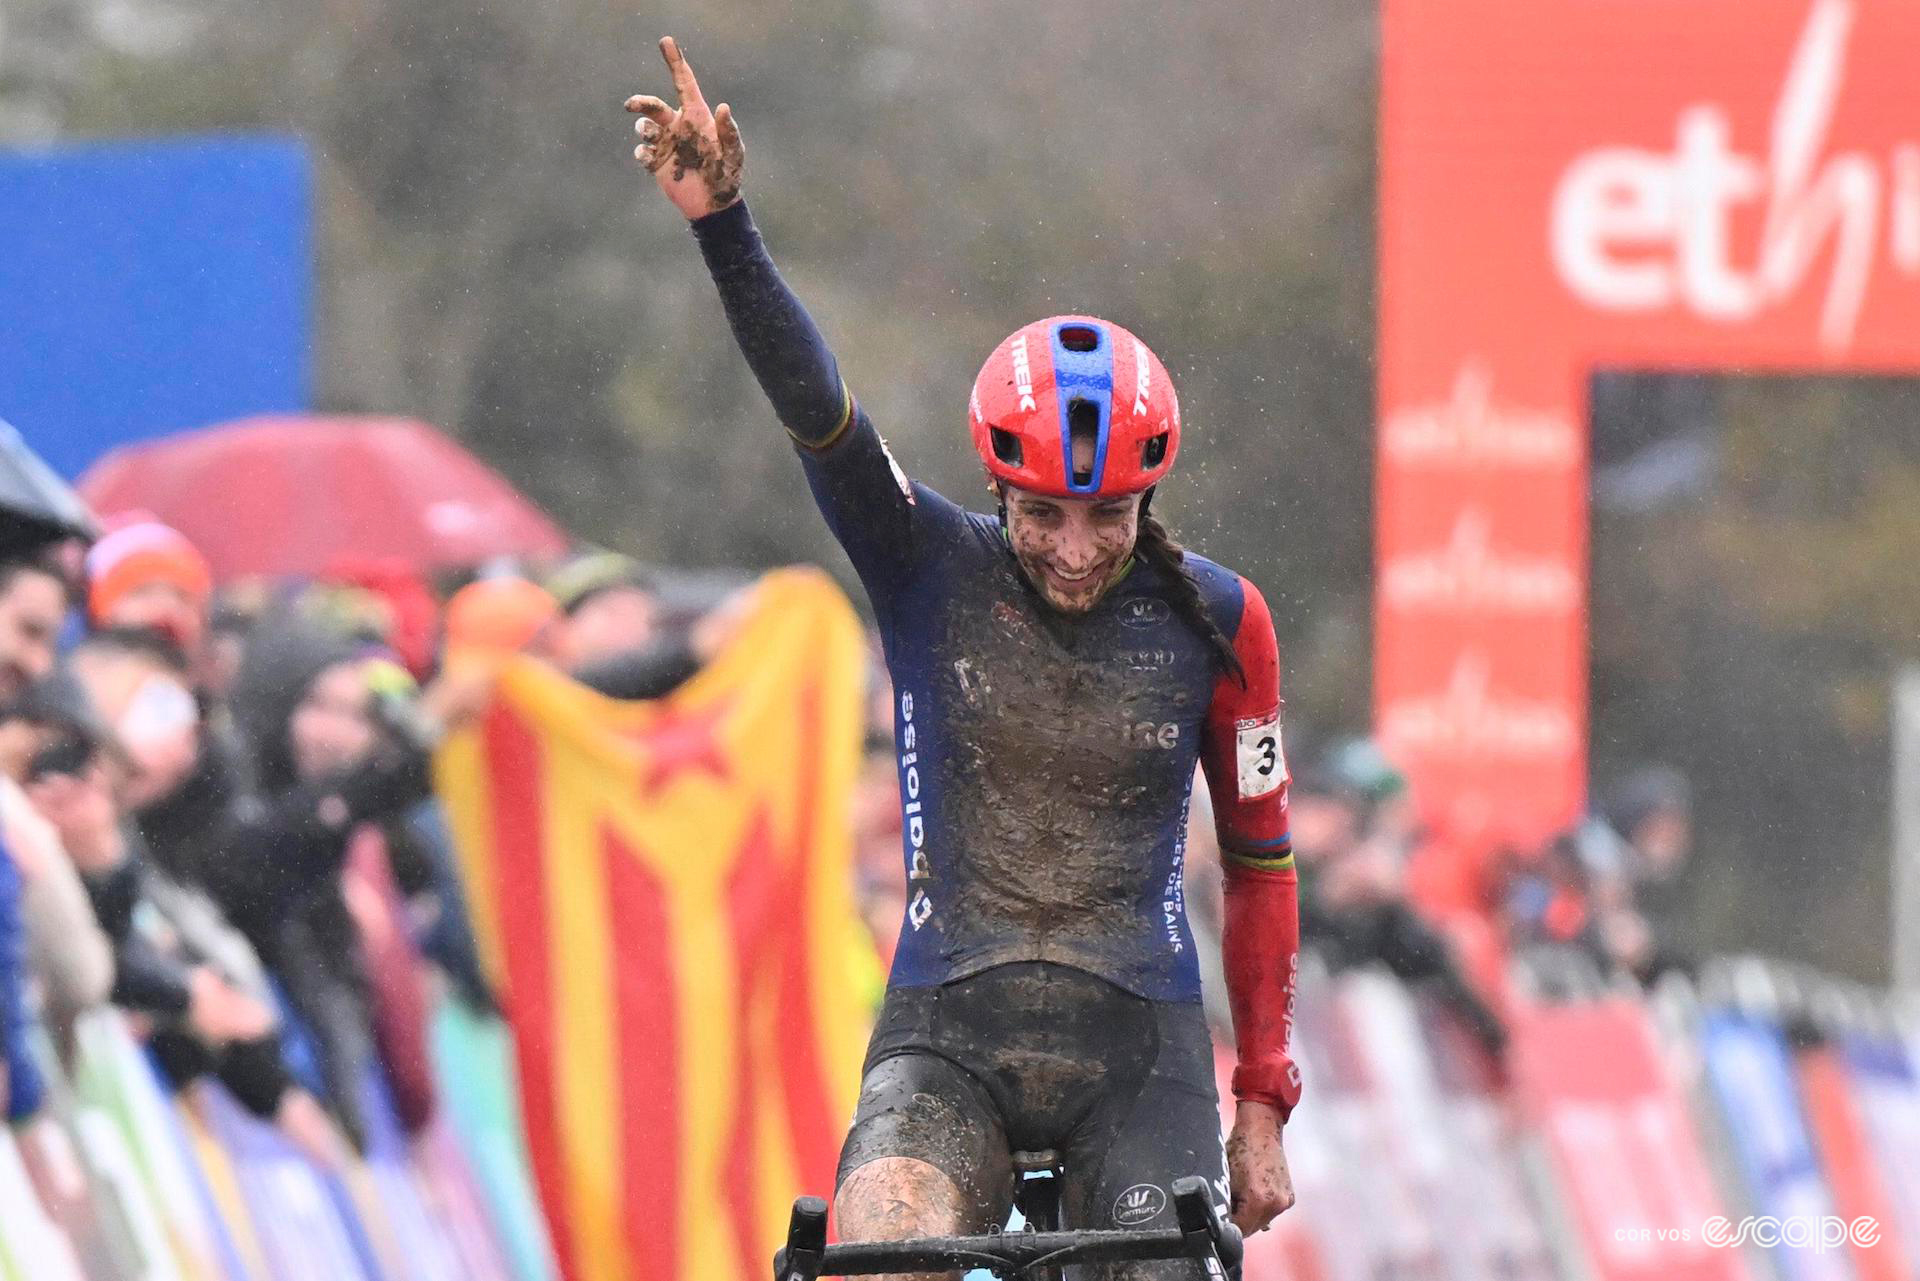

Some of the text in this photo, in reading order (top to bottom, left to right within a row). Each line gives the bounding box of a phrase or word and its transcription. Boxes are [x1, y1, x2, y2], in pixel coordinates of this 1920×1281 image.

[1011, 335, 1037, 412] TREK
[1256, 736, 1277, 776] 3
[1162, 901, 1184, 954] BAINS
